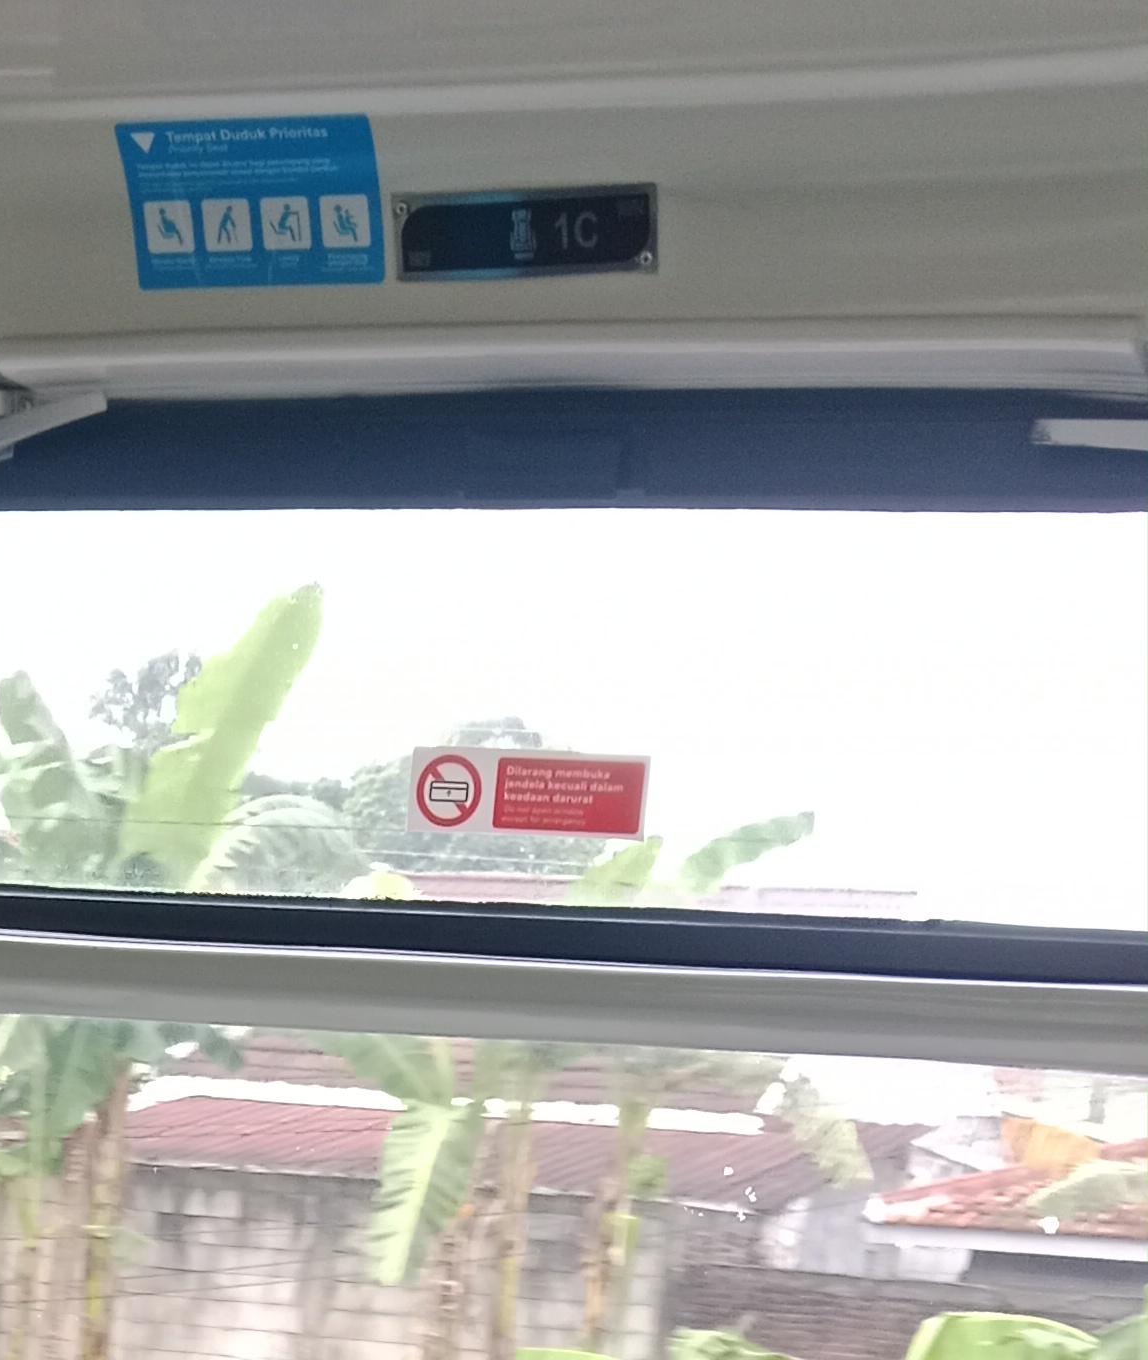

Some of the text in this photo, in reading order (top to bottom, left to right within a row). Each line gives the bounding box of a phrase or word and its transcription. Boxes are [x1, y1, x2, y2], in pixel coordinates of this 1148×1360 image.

[165, 127, 328, 145] Tempat Duduk Prioritas
[554, 211, 598, 250] 1C
[506, 765, 611, 780] Dilarang membuka
[504, 778, 624, 792] jendela kecuali dalam
[503, 791, 593, 804] keadaan darurat
